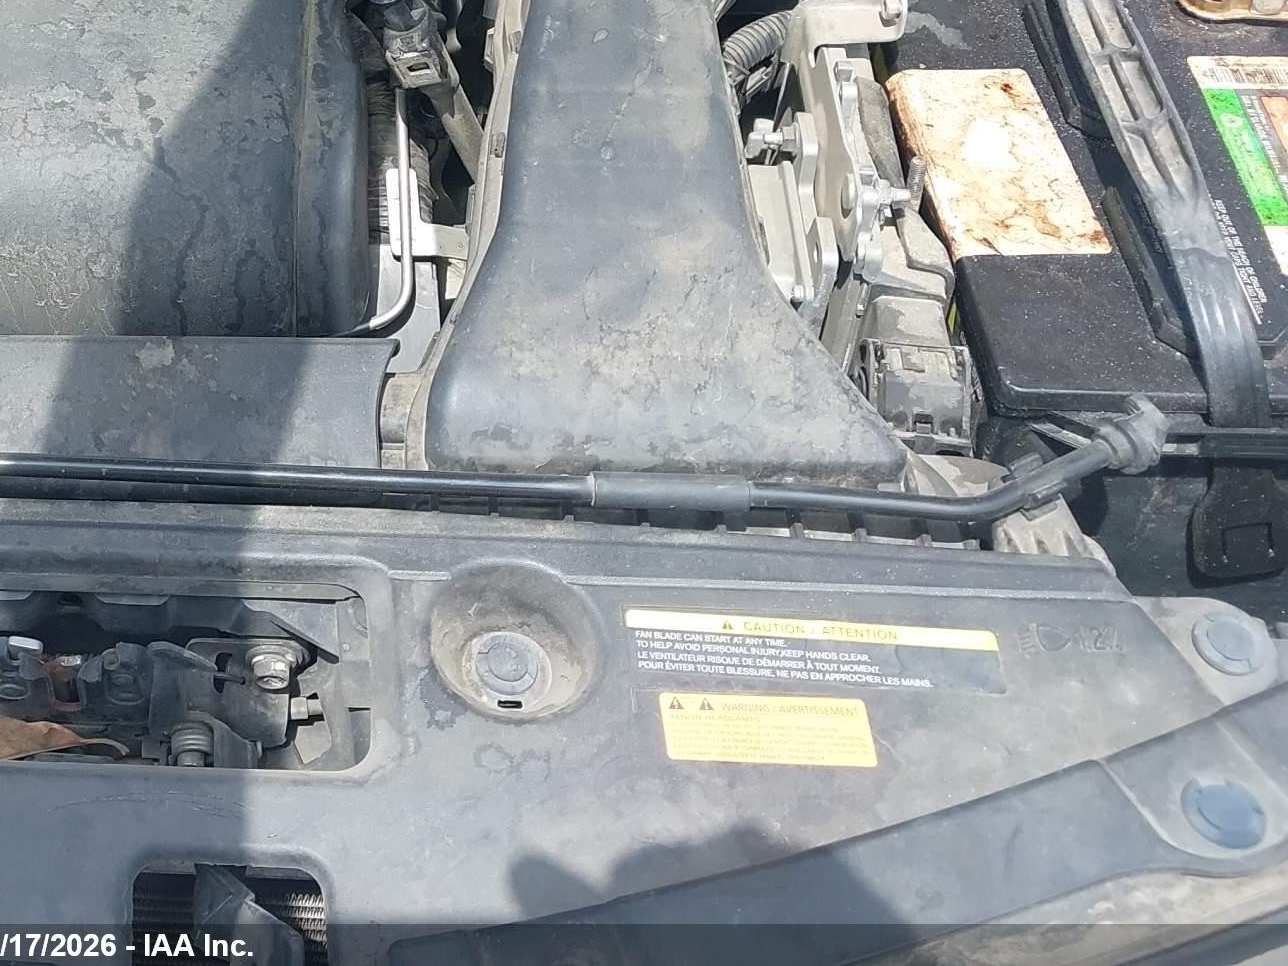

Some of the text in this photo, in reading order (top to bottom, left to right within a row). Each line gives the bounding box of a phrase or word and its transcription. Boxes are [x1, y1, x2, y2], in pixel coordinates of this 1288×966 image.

[635, 630, 652, 639] FAN
[653, 631, 683, 641] BLADE
[684, 633, 703, 643] CAN
[704, 635, 731, 644] START
[732, 637, 744, 645] AT
[745, 637, 763, 646] ANY
[743, 621, 805, 635] CAUTION
[822, 626, 898, 641] ATTENTION
[636, 640, 649, 649] TO
[650, 641, 672, 651] HELP
[673, 642, 701, 652] AVOID
[702, 643, 750, 655] PERSONAL
[806, 650, 838, 661] HANDS
[637, 651, 649, 659] LE
[650, 652, 706, 663] VENTILATEUR
[707, 655, 741, 666] RISQUE
[742, 657, 753, 666] DE
[755, 656, 805, 669] DÉMARRER
[815, 661, 838, 671] TOUT
[638, 661, 664, 670] POUR
[665, 660, 695, 672] ÉVITER
[696, 664, 727, 674] TOUTE
[776, 669, 790, 679] NE
[790, 670, 809, 680] PAS
[810, 671, 824, 681] EN
[824, 672, 882, 684] APPROCHER
[883, 677, 901, 686] LES
[721, 704, 770, 713] WARNING
[779, 705, 859, 716] AVERTISSEMENT
